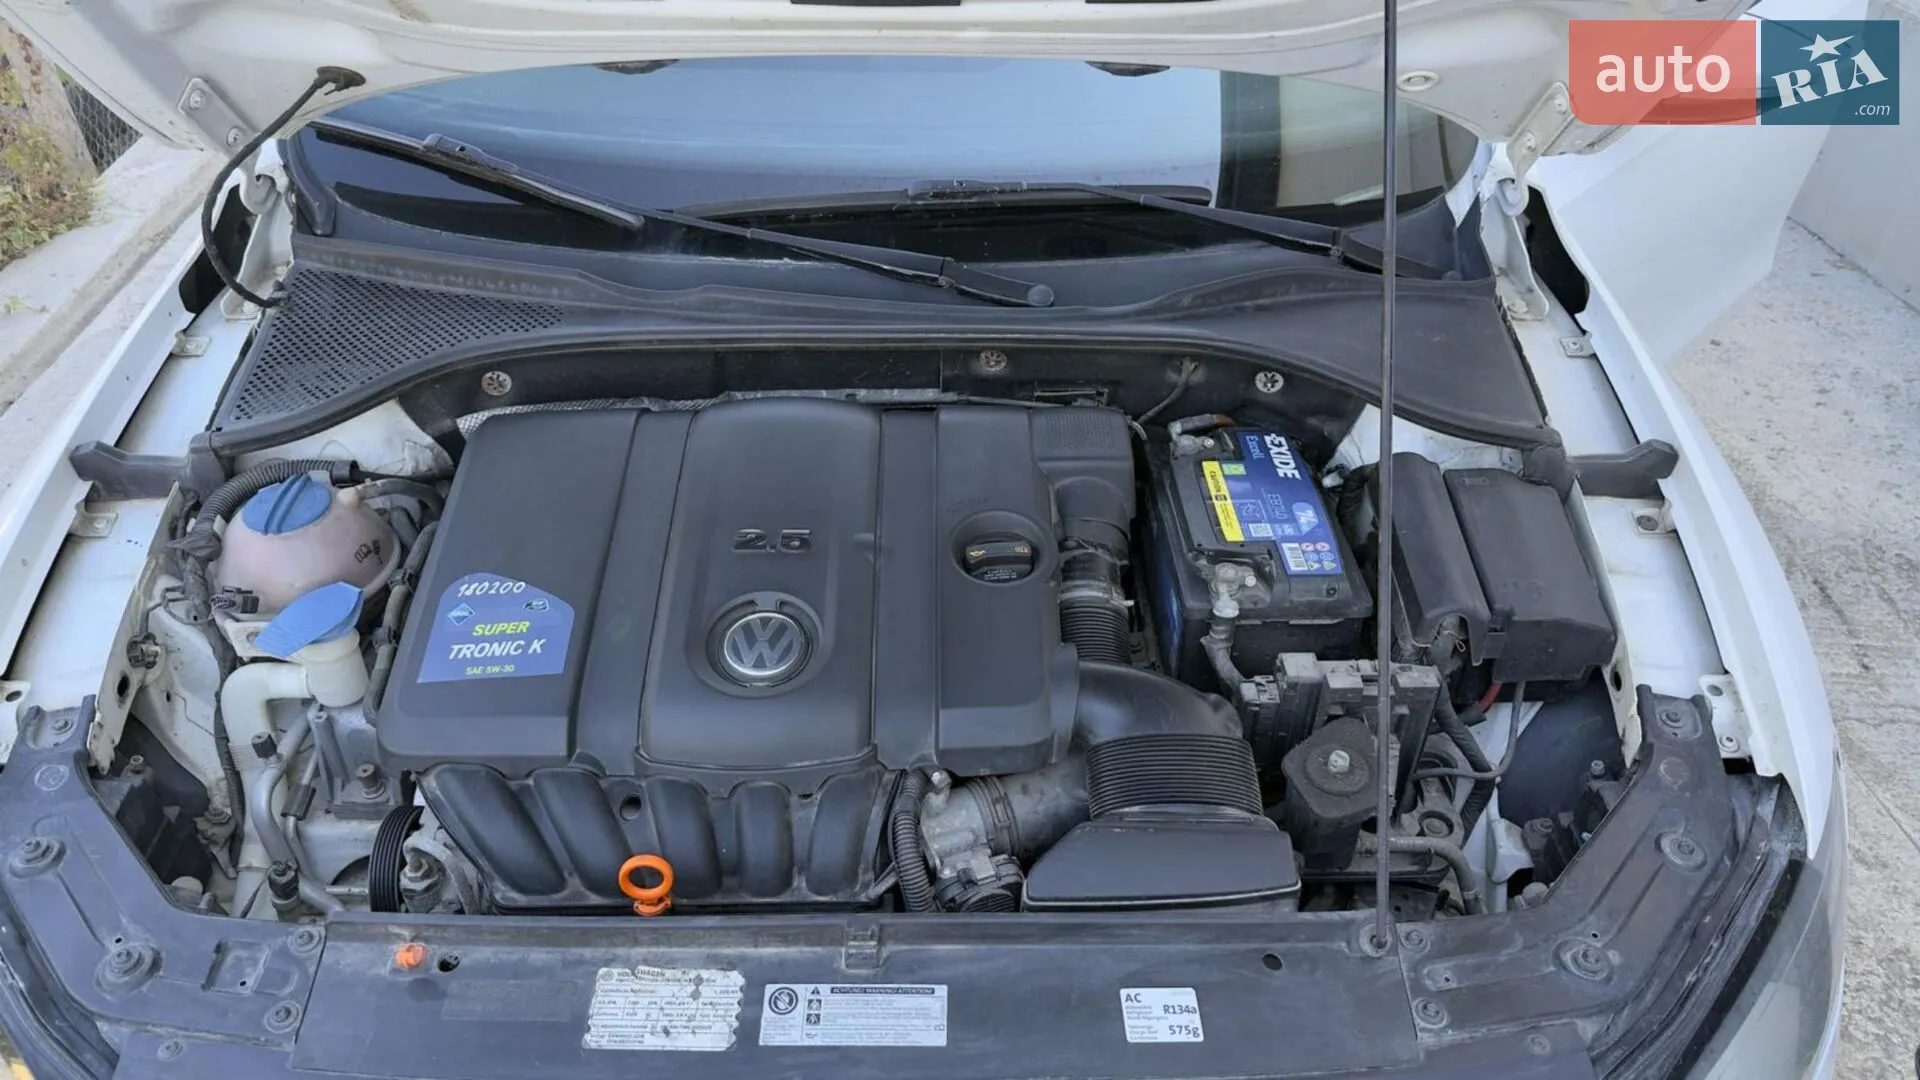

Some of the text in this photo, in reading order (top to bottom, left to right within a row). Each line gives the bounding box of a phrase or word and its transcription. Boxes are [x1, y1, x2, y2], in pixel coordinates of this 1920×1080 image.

[1264, 433, 1302, 481] EXIDE
[731, 528, 813, 554] 2.5
[457, 582, 525, 597] 180200
[472, 621, 531, 637] SUPER
[449, 638, 547, 660] TRONIC K
[465, 665, 483, 675] SAE
[1125, 993, 1142, 1003] AC
[1163, 1004, 1197, 1015] R134a
[1168, 1024, 1201, 1039] 575g
